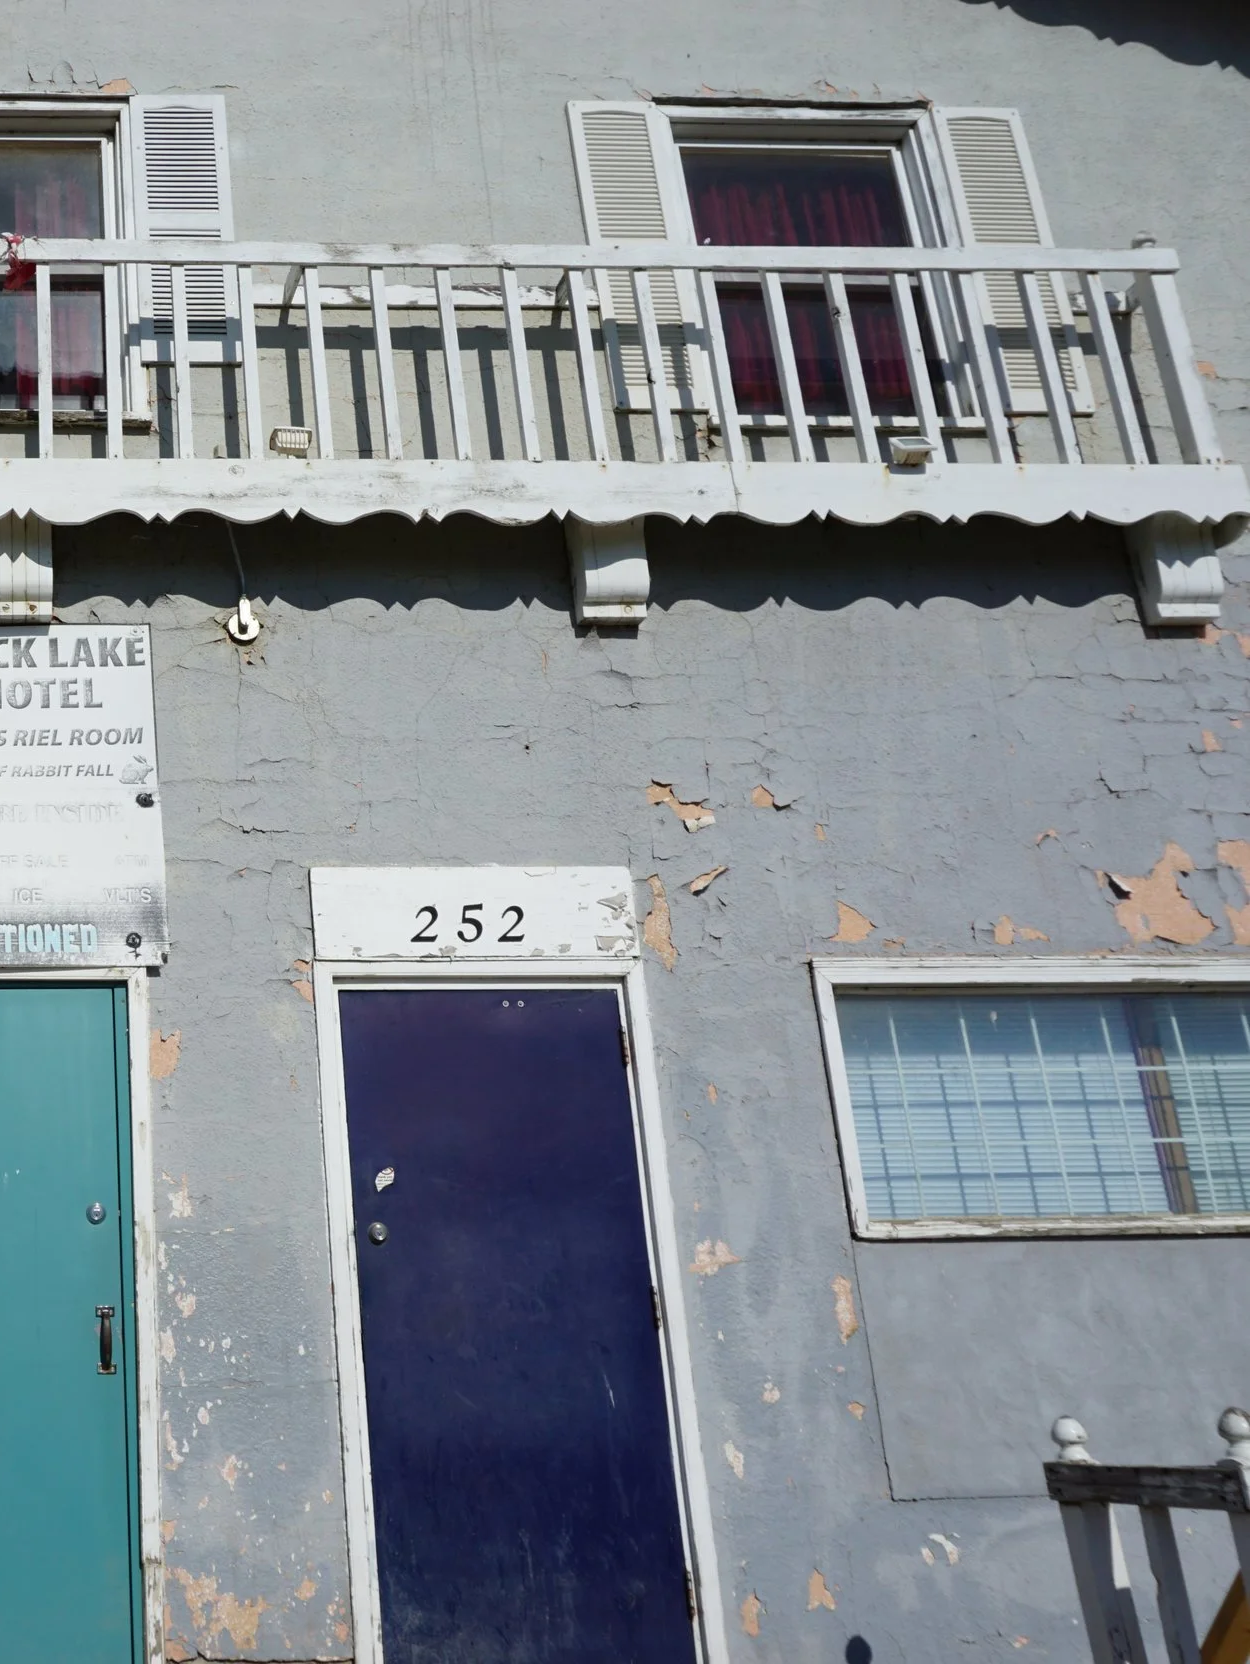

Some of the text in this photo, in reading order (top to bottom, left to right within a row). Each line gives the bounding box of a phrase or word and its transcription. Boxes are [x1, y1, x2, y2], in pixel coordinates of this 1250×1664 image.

[49, 636, 146, 668] LAKE
[13, 728, 63, 747] RIEL
[68, 727, 144, 746] ROOM
[11, 764, 72, 778] RABBIT
[75, 764, 114, 778] FALL
[13, 887, 44, 904] ICE
[410, 903, 525, 943] 252
